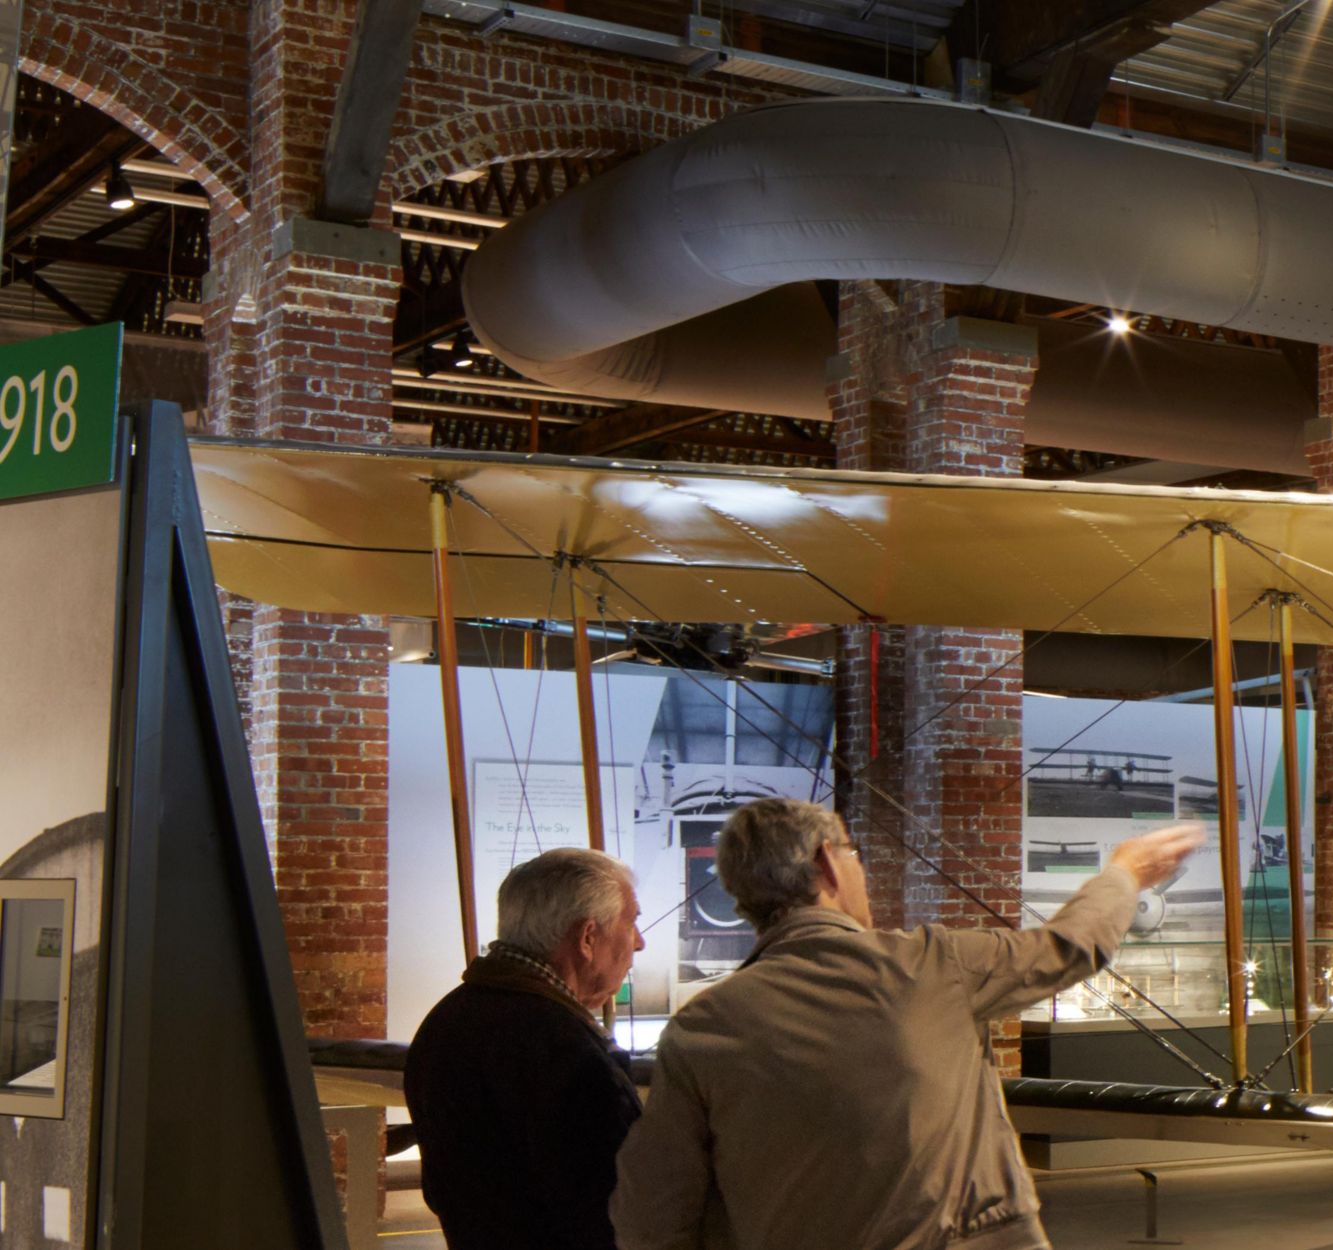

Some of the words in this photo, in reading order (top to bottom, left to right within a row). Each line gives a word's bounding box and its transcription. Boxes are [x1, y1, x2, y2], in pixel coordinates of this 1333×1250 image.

[0, 364, 78, 464] 918
[486, 822, 504, 832] The
[554, 822, 571, 834] Sky
